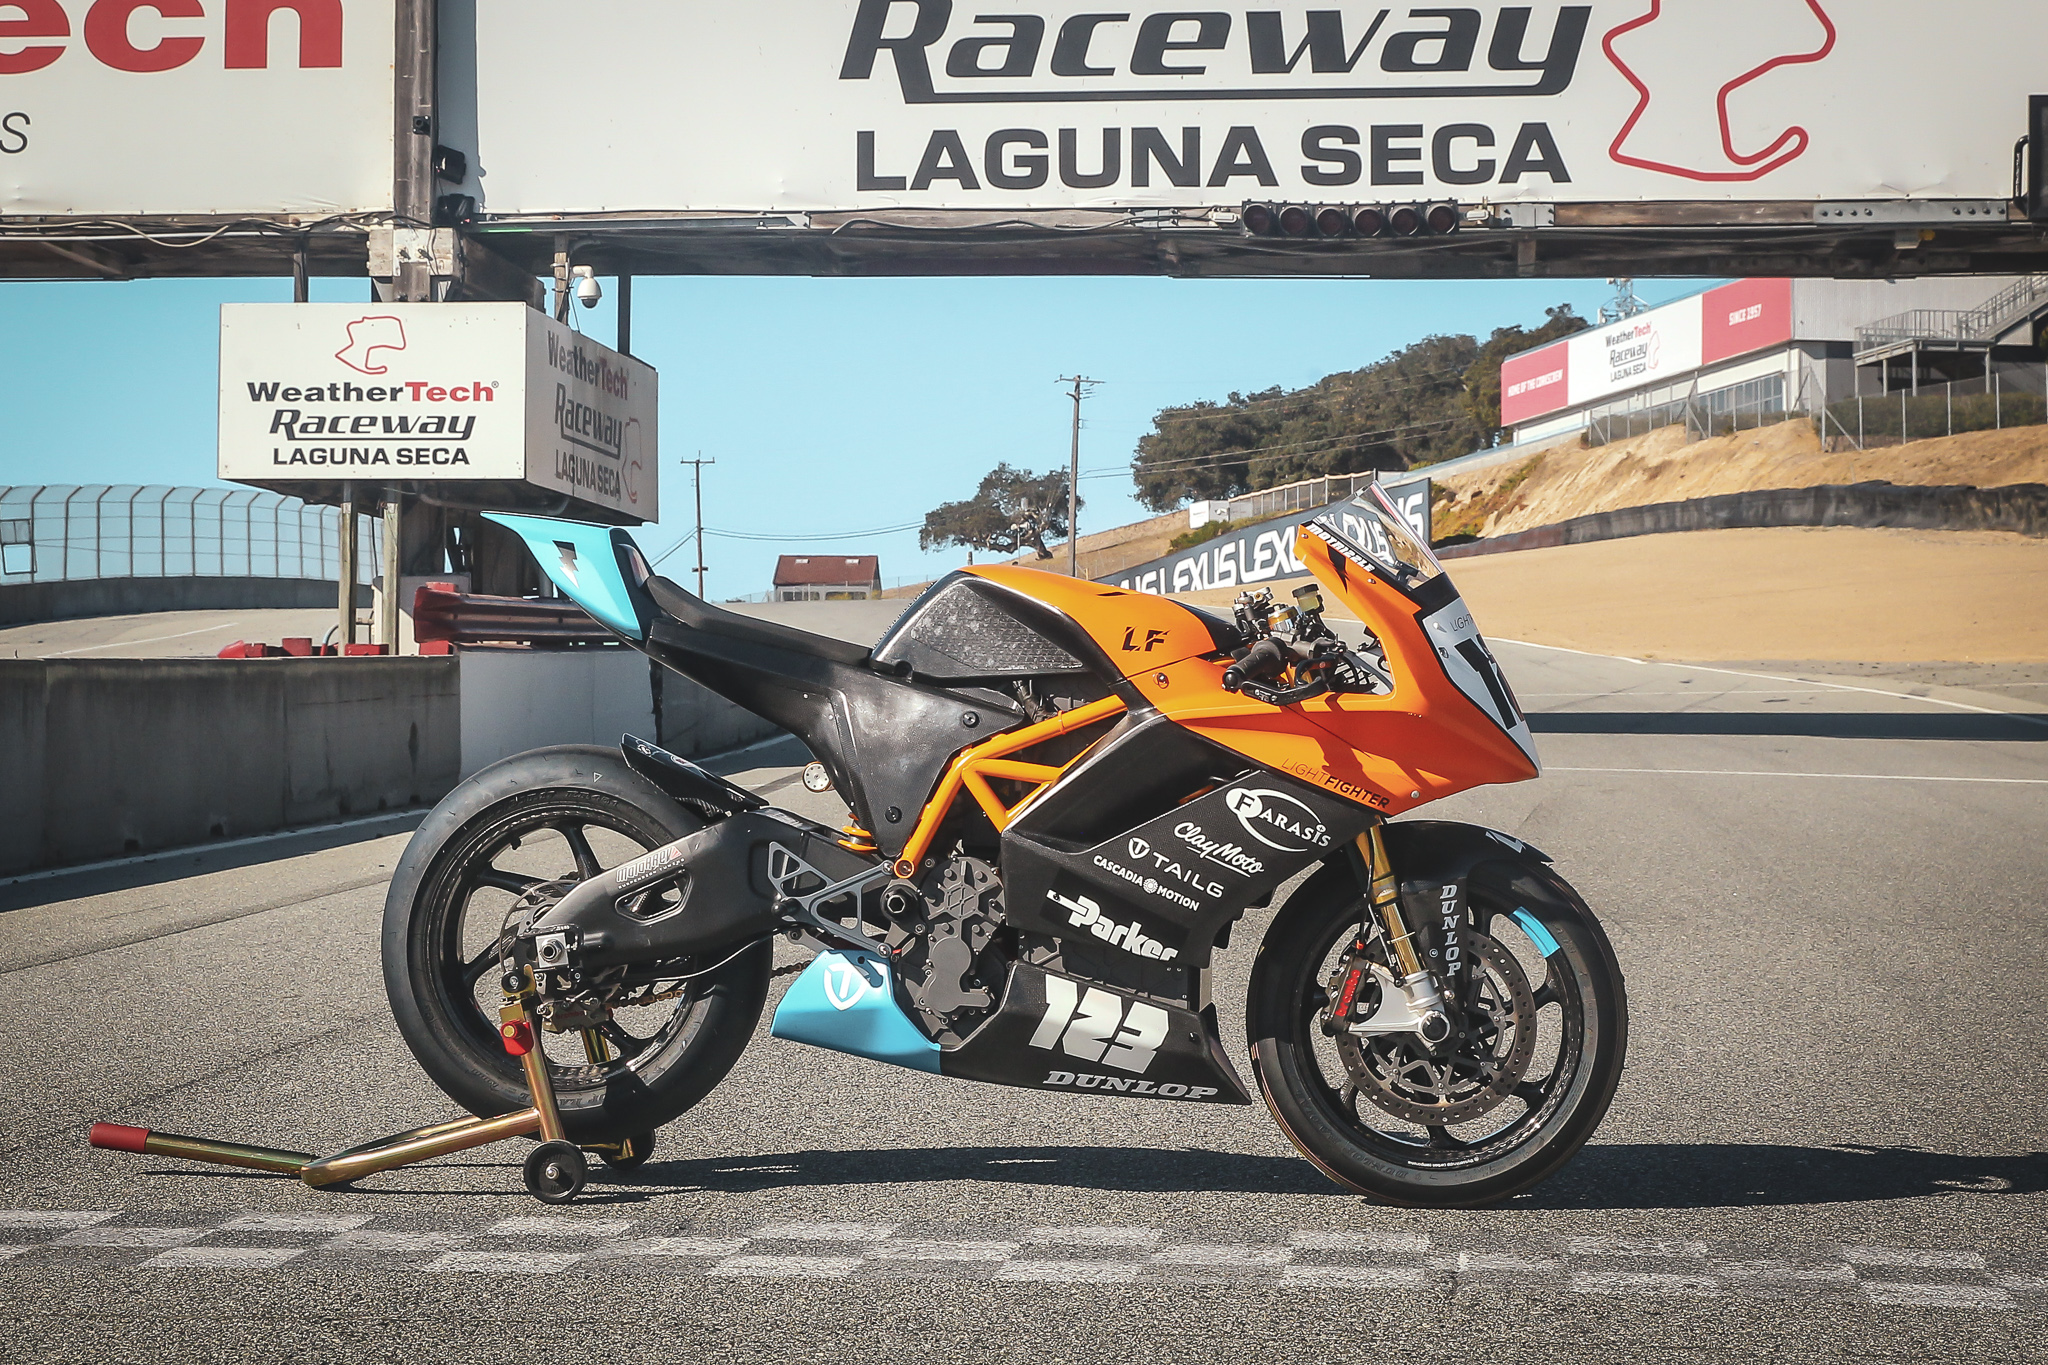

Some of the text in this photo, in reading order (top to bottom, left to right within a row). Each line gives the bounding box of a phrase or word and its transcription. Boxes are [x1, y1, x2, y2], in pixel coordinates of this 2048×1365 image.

[840, 0, 1592, 104] Raceway
[855, 121, 1572, 192] LAGUNA SECA
[1605, 321, 1651, 348] WeatherTech
[1610, 342, 1648, 368] Raceway
[548, 330, 628, 400] WeatherTech
[247, 381, 495, 403] WeatherTech
[269, 408, 477, 442] Raceway
[555, 382, 623, 461] Raceway
[272, 447, 470, 466] LAGUNA SECA
[555, 448, 622, 500] LAGUNA SECA
[1121, 626, 1171, 652] LF
[1234, 792, 1332, 848] FARASIS
[1093, 854, 1200, 912] CASCADIA MOTION
[1152, 851, 1225, 899] TAILG
[1047, 889, 1179, 962] Parker
[1439, 884, 1461, 977] DUNLOP
[1334, 969, 1362, 1017] brembo
[1029, 973, 1170, 1075] 123
[1043, 1069, 1219, 1099] DUNLOP
